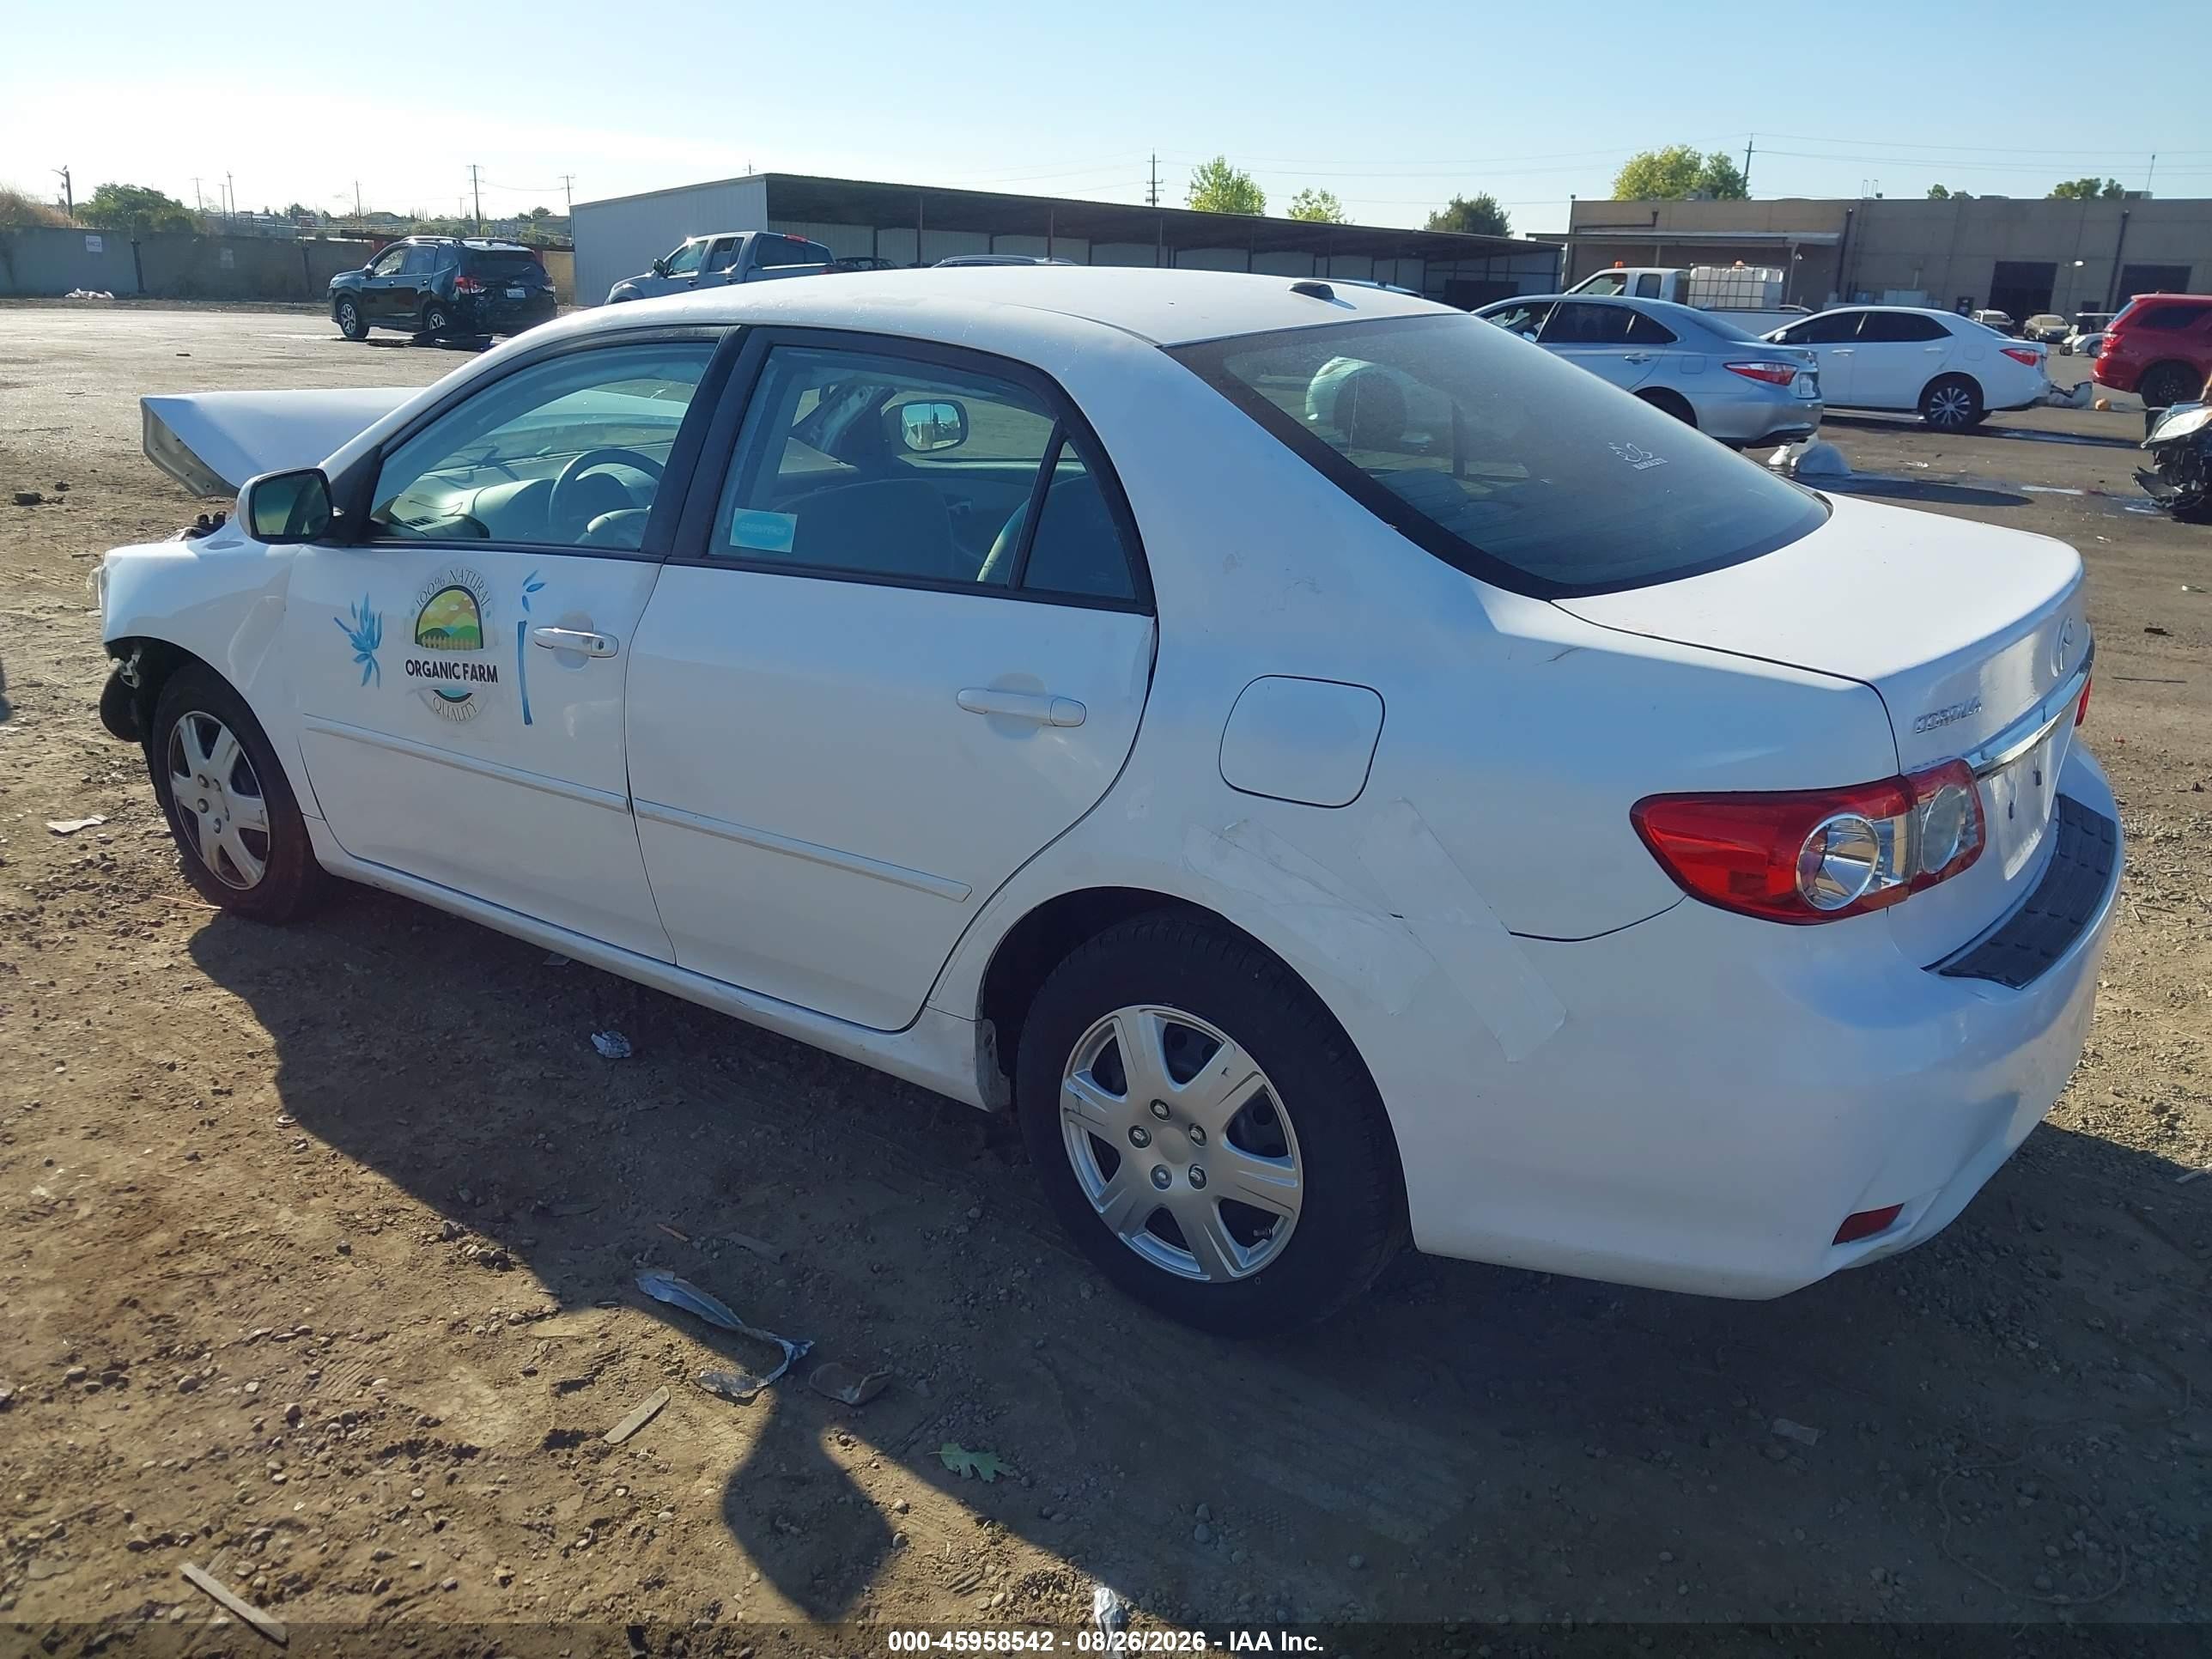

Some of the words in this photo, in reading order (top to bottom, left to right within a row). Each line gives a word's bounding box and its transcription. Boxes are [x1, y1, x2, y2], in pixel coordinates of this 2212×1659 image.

[416, 576, 446, 608] 100%
[447, 568, 490, 611] NATURAL
[405, 659, 461, 680] ORGANIC
[462, 663, 498, 683] FARM
[433, 696, 477, 722] QUALITY
[1914, 696, 1982, 734] COROLLA
